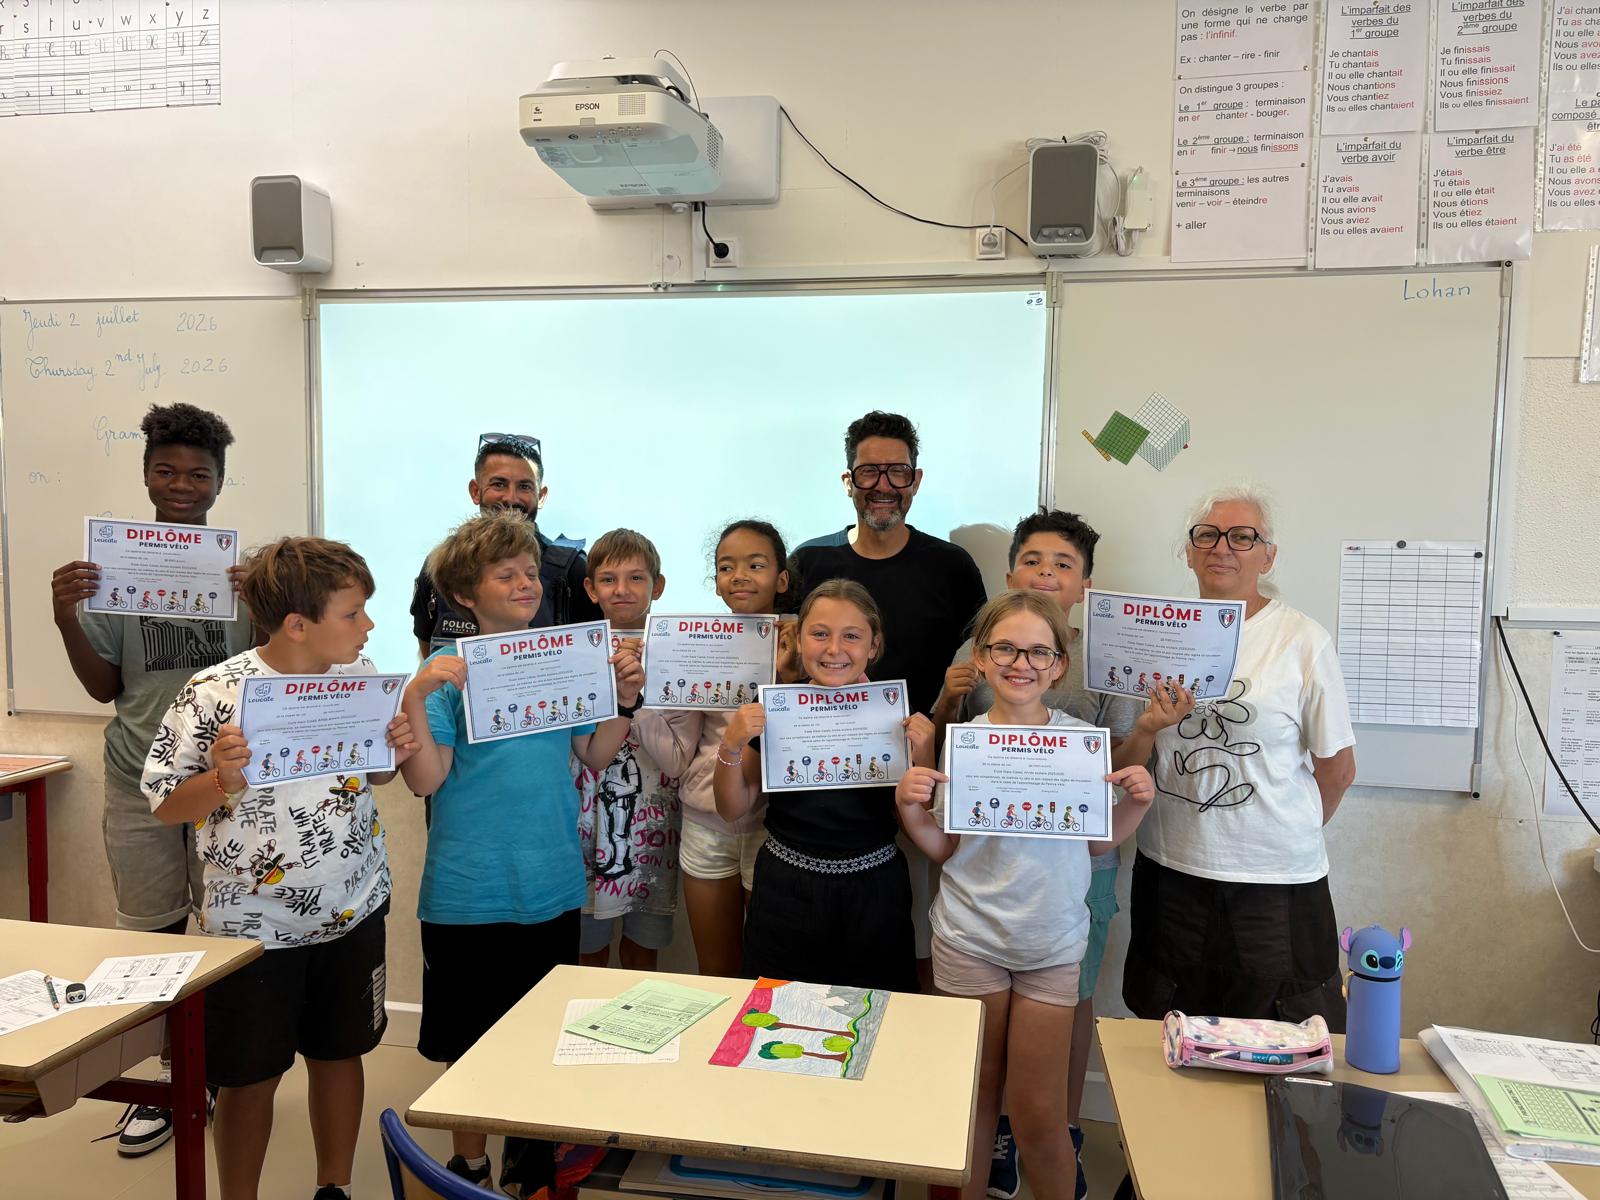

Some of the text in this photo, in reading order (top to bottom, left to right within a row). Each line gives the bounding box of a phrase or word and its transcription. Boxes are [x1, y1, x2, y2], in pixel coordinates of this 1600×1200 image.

[1181, 2, 1309, 18] On désigne le verbe par
[1341, 3, 1411, 15] L'imparfait des
[1181, 14, 1308, 30] une forme qui ne change
[1352, 16, 1399, 27] verbes du
[1180, 34, 1198, 43] pas
[1365, 28, 1399, 38] groupe
[1342, 50, 1379, 58] chantais
[1440, 45, 1490, 55] Je finissais
[1180, 50, 1280, 64] Ex chanter rire finir
[1329, 60, 1379, 69] Tu chantais
[1349, 71, 1364, 79] elle
[1367, 69, 1403, 78] chantait
[1179, 81, 1279, 94] On distingue 3 groupes
[1327, 81, 1396, 91] Nous chantions
[1440, 77, 1509, 88] Nous finissions
[1327, 93, 1389, 102] Vous chantiez
[1466, 88, 1502, 98] finissiez
[575, 102, 600, 111] EPSON
[1179, 103, 1190, 112] Le
[1213, 100, 1244, 111] groupe
[1255, 97, 1306, 107] terminaison
[1370, 101, 1414, 110] chantaient
[1178, 115, 1189, 123] en
[1191, 114, 1200, 122] er
[1215, 111, 1248, 120] chanter
[1177, 138, 1188, 146] Le
[1213, 135, 1244, 145] groupe
[1253, 132, 1304, 142] terminaison
[1447, 134, 1514, 146] L'imparfait du
[1177, 148, 1187, 156] en
[1211, 146, 1227, 154] finir
[1237, 146, 1258, 154] nous
[1260, 143, 1299, 152] finissons
[1336, 141, 1401, 152] L'imparfait du
[1455, 146, 1506, 157] verbe être
[1341, 153, 1396, 163] verbe avoir
[1433, 169, 1463, 177] J'étais
[1177, 180, 1187, 188] Le
[1209, 177, 1240, 187] groupe
[1247, 176, 1260, 184] les
[1262, 174, 1289, 183] autres
[1322, 175, 1353, 183] J'avais
[1176, 189, 1230, 197] terminaisons
[1176, 197, 1268, 208] venir voir éteindre
[1185, 221, 1207, 230] aller
[1403, 278, 1471, 300] Lohan
[23, 305, 217, 350] Jeudi 2 juillet 2026
[25, 357, 97, 391] Thursday
[180, 358, 229, 375] 2026
[127, 528, 202, 545] DIPLÔME
[139, 541, 168, 549] PERMIS
[1123, 603, 1202, 622] DIPLÔME
[442, 620, 477, 630] POLICE
[679, 619, 744, 634] DIPLÔME
[1135, 618, 1188, 629] PERMIS VÉLO
[500, 634, 573, 655] DIPLÔME
[513, 652, 542, 661] PERMIS
[285, 680, 367, 695] DIPLÔME
[297, 692, 351, 702] PERMIS VÉLO
[798, 691, 869, 705] DIPLÔME
[839, 703, 858, 711] VÉLO
[988, 732, 1068, 748] DIPLÔME
[1002, 746, 1055, 755] PERMIS VÉLO
[257, 786, 277, 834] PIRATE
[633, 853, 662, 867] JOIN
